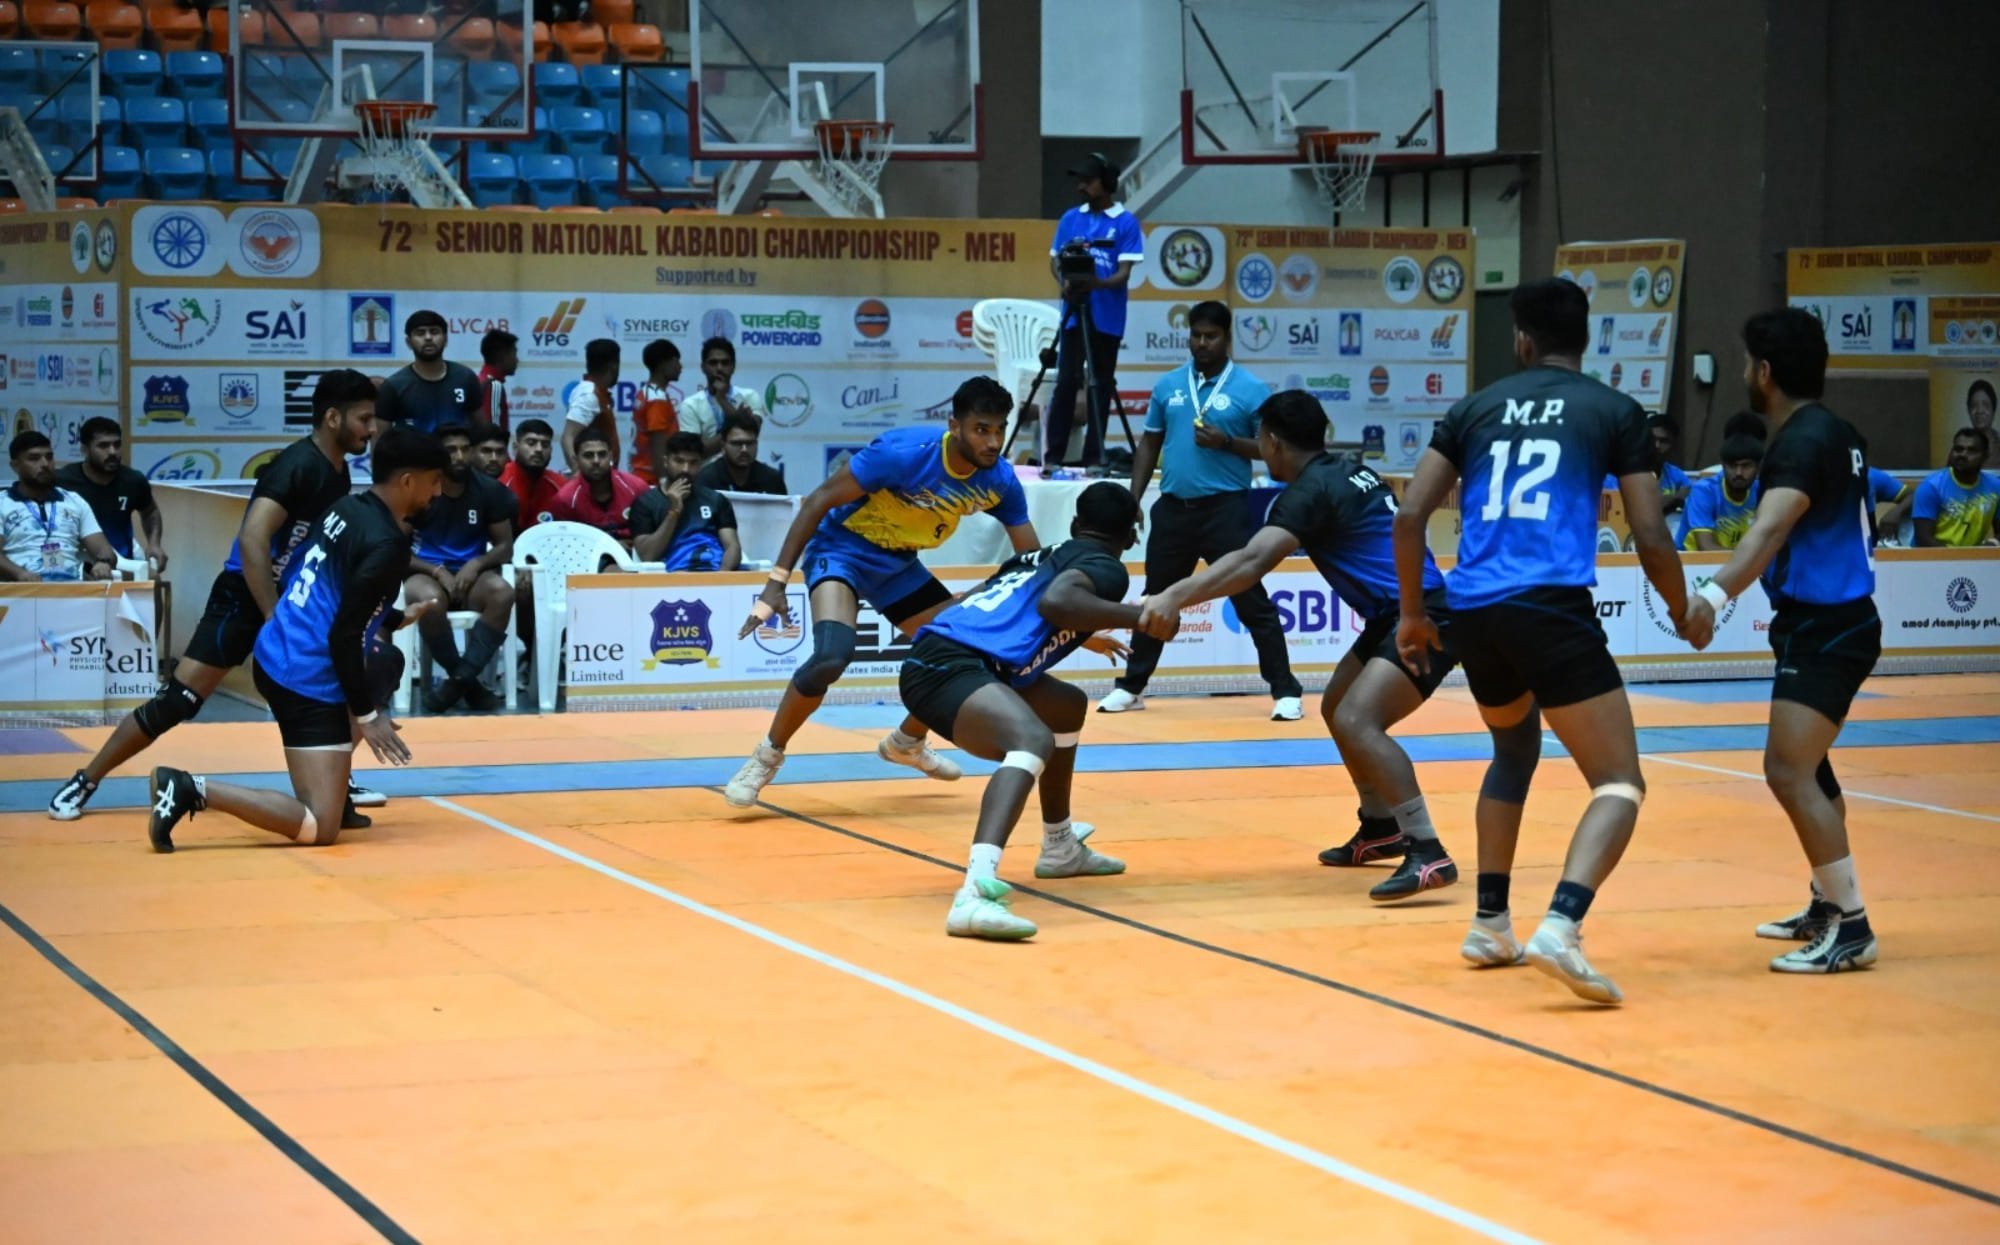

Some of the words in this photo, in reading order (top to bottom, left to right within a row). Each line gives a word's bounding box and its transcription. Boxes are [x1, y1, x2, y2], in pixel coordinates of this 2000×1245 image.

[436, 221, 523, 254] SENIOR
[532, 223, 648, 257] NATIONAL
[656, 225, 758, 258] KABADDI
[764, 227, 940, 261] CHAMPIONSHIP
[965, 231, 1016, 263] MEN
[655, 266, 735, 287] Supported
[738, 267, 757, 287] by
[245, 310, 306, 340] SAI
[624, 318, 690, 334] SYNERGY
[741, 310, 822, 330] पावरग्रिड
[1842, 313, 1872, 338] SAI
[533, 333, 569, 347] YPG
[741, 331, 822, 346] POWERGRID
[1288, 323, 1319, 344] SAI
[47, 355, 63, 381] SBI
[454, 389, 465, 403] 3
[1502, 399, 1563, 425] M.P.
[1482, 439, 1561, 521] 12
[118, 496, 128, 511] 7
[323, 511, 347, 543] M.P.
[819, 557, 829, 574] 9
[288, 544, 327, 608] 5
[1269, 590, 1340, 633] SBI
[663, 626, 700, 639] KJVS
[1178, 620, 1212, 633] aroda
[1902, 618, 1930, 629] amod
[1932, 617, 1981, 631] stampings
[573, 643, 624, 662] nce
[571, 669, 624, 682] Limited
[871, 666, 894, 674] India
[106, 682, 156, 696] dustri
